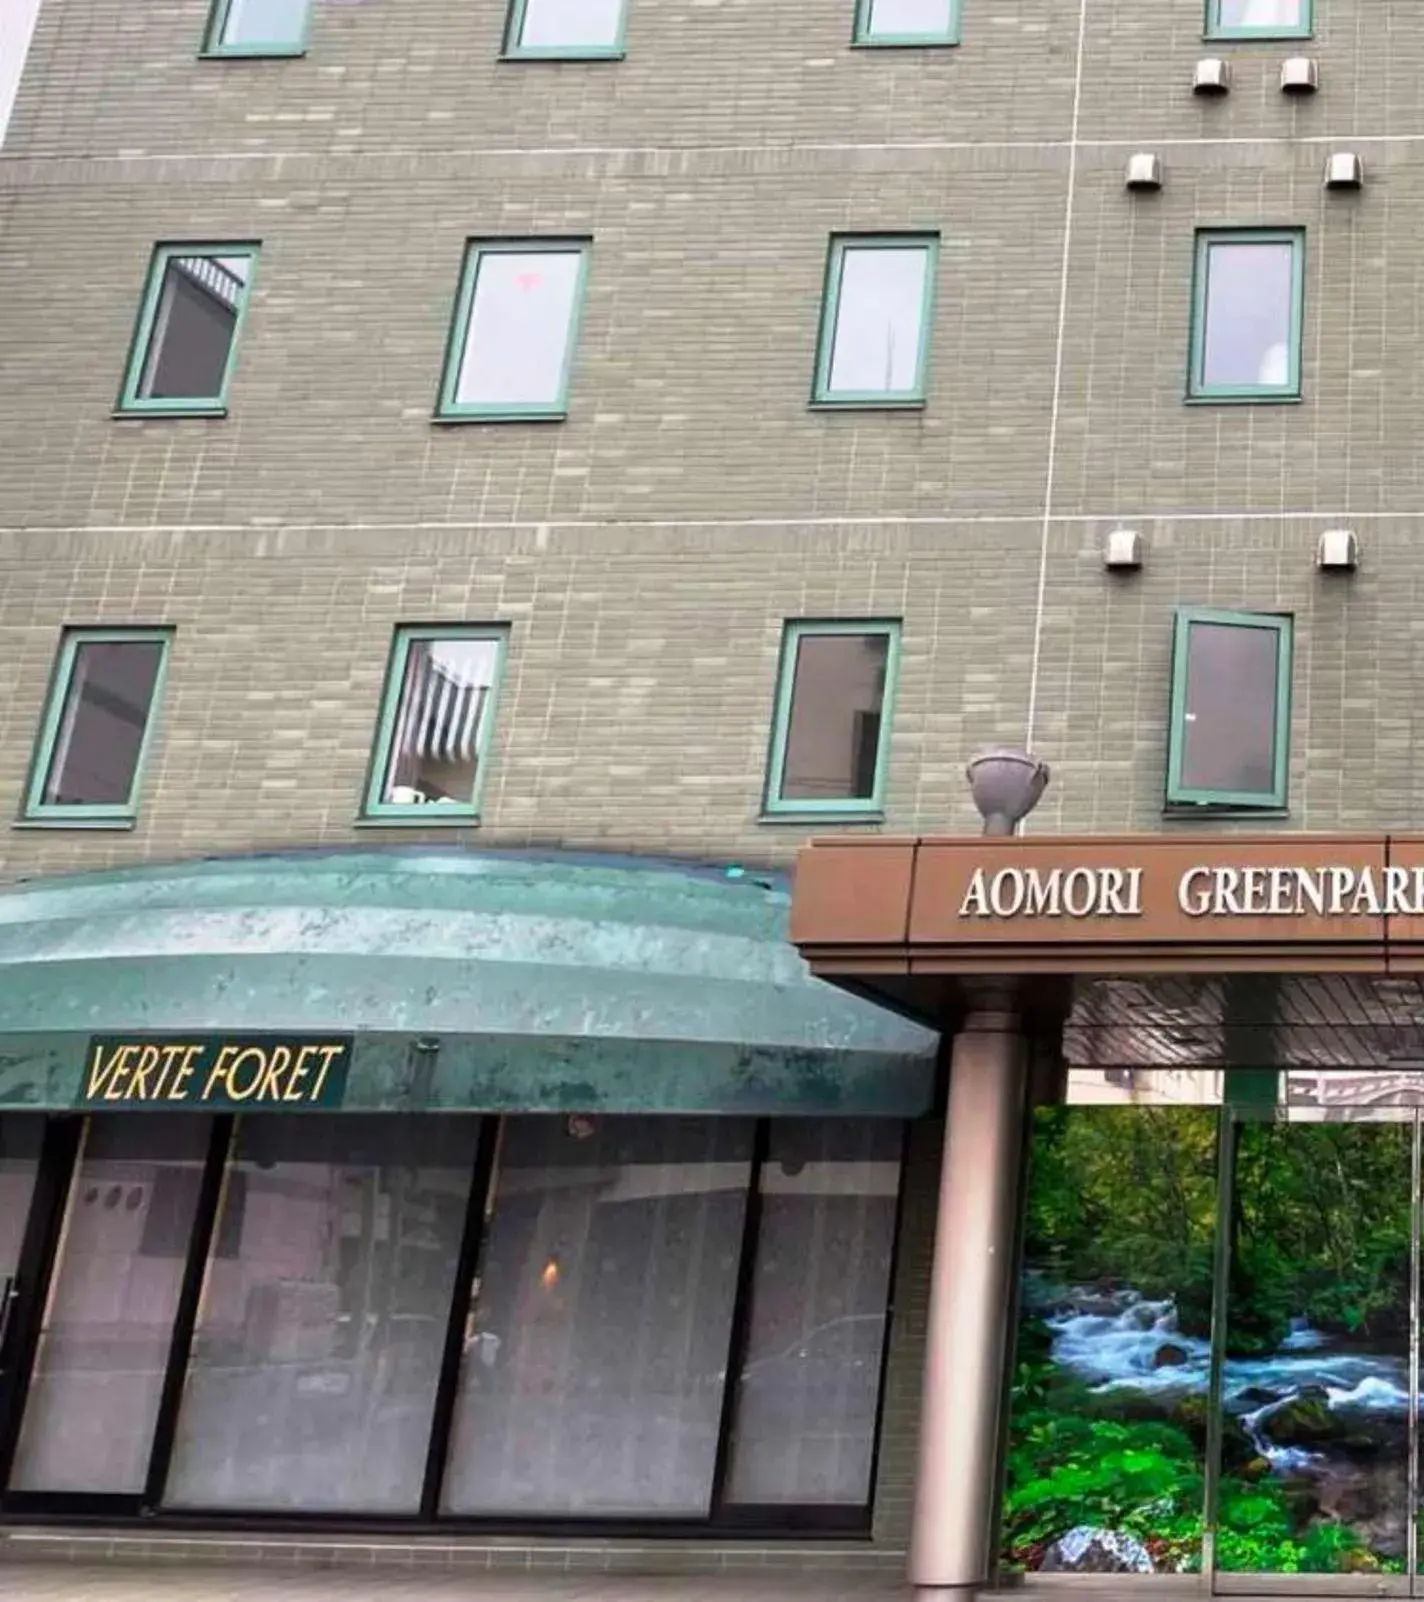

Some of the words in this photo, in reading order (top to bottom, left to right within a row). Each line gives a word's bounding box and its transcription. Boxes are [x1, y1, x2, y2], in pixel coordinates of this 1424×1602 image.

[959, 867, 1142, 917] AOMORI
[86, 1045, 206, 1101] VERTE
[201, 1045, 345, 1101] FORET
